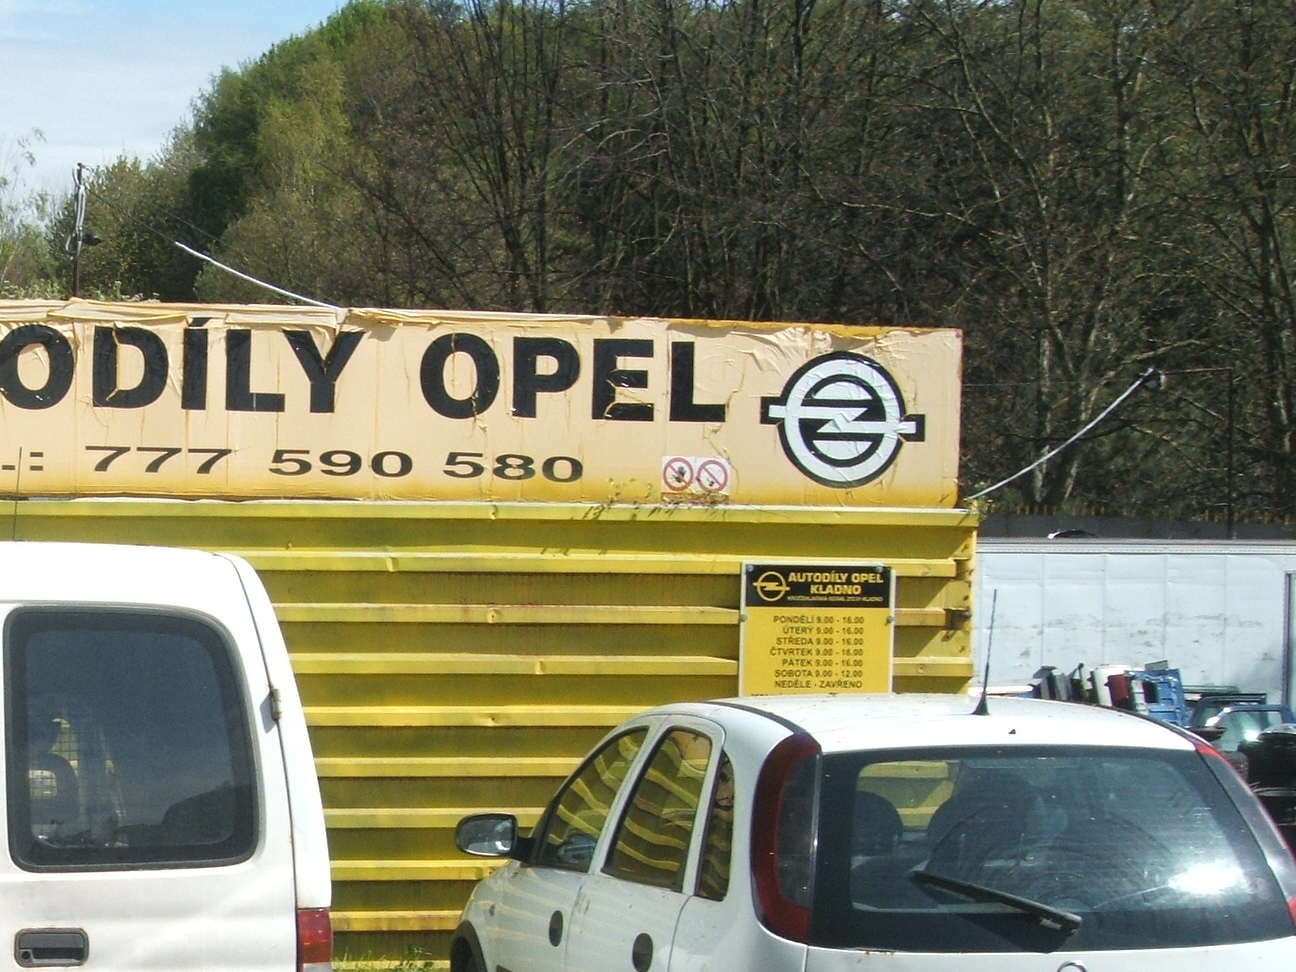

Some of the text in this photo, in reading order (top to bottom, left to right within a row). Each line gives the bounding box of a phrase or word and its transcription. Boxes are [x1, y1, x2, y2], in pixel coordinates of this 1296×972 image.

[420, 332, 726, 422] OPEL
[85, 446, 232, 474] 777
[269, 449, 413, 478] 590
[443, 451, 584, 483] 580
[788, 570, 884, 583] AUTODÍLY OPEL
[810, 584, 862, 595] KLADNO
[773, 614, 814, 624] PONDĚLÍ
[776, 635, 814, 646] STŘEDA
[769, 646, 813, 656] ČTVRTEK
[774, 669, 813, 678] SOBOTA
[774, 679, 812, 689] NEDĚLE
[819, 679, 863, 689] ZAVŘENO
